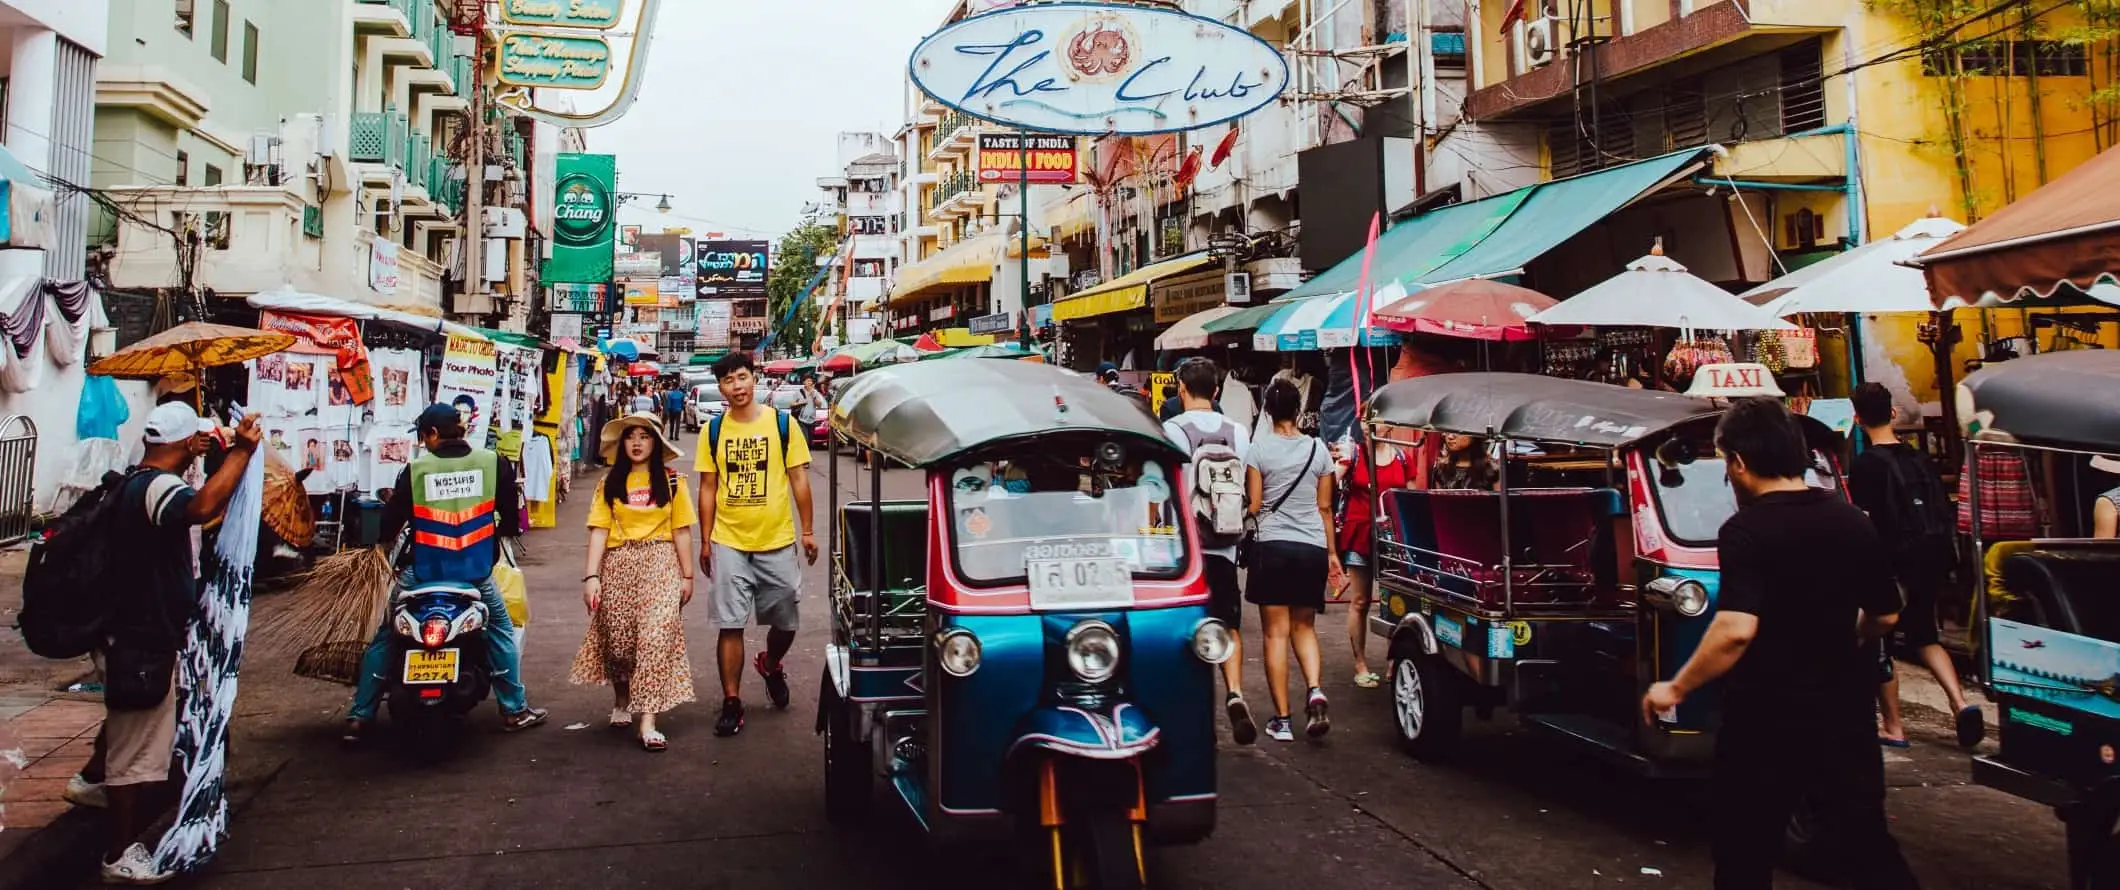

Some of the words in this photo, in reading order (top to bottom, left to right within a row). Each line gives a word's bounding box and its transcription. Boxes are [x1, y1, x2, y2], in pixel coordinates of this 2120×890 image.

[954, 29, 1070, 104] The
[1116, 56, 1262, 101] Club
[983, 138, 1020, 149] TASTE
[1037, 138, 1070, 149] INDIA
[980, 151, 1033, 169] INDIAN
[1035, 152, 1073, 170] FOOD
[555, 204, 604, 223] Chang
[446, 362, 467, 373] Your
[467, 365, 495, 377] Photo
[1708, 368, 1764, 388] TAXI
[742, 438, 757, 449] AM
[729, 449, 750, 461] ONE
[735, 483, 757, 495] FIE
